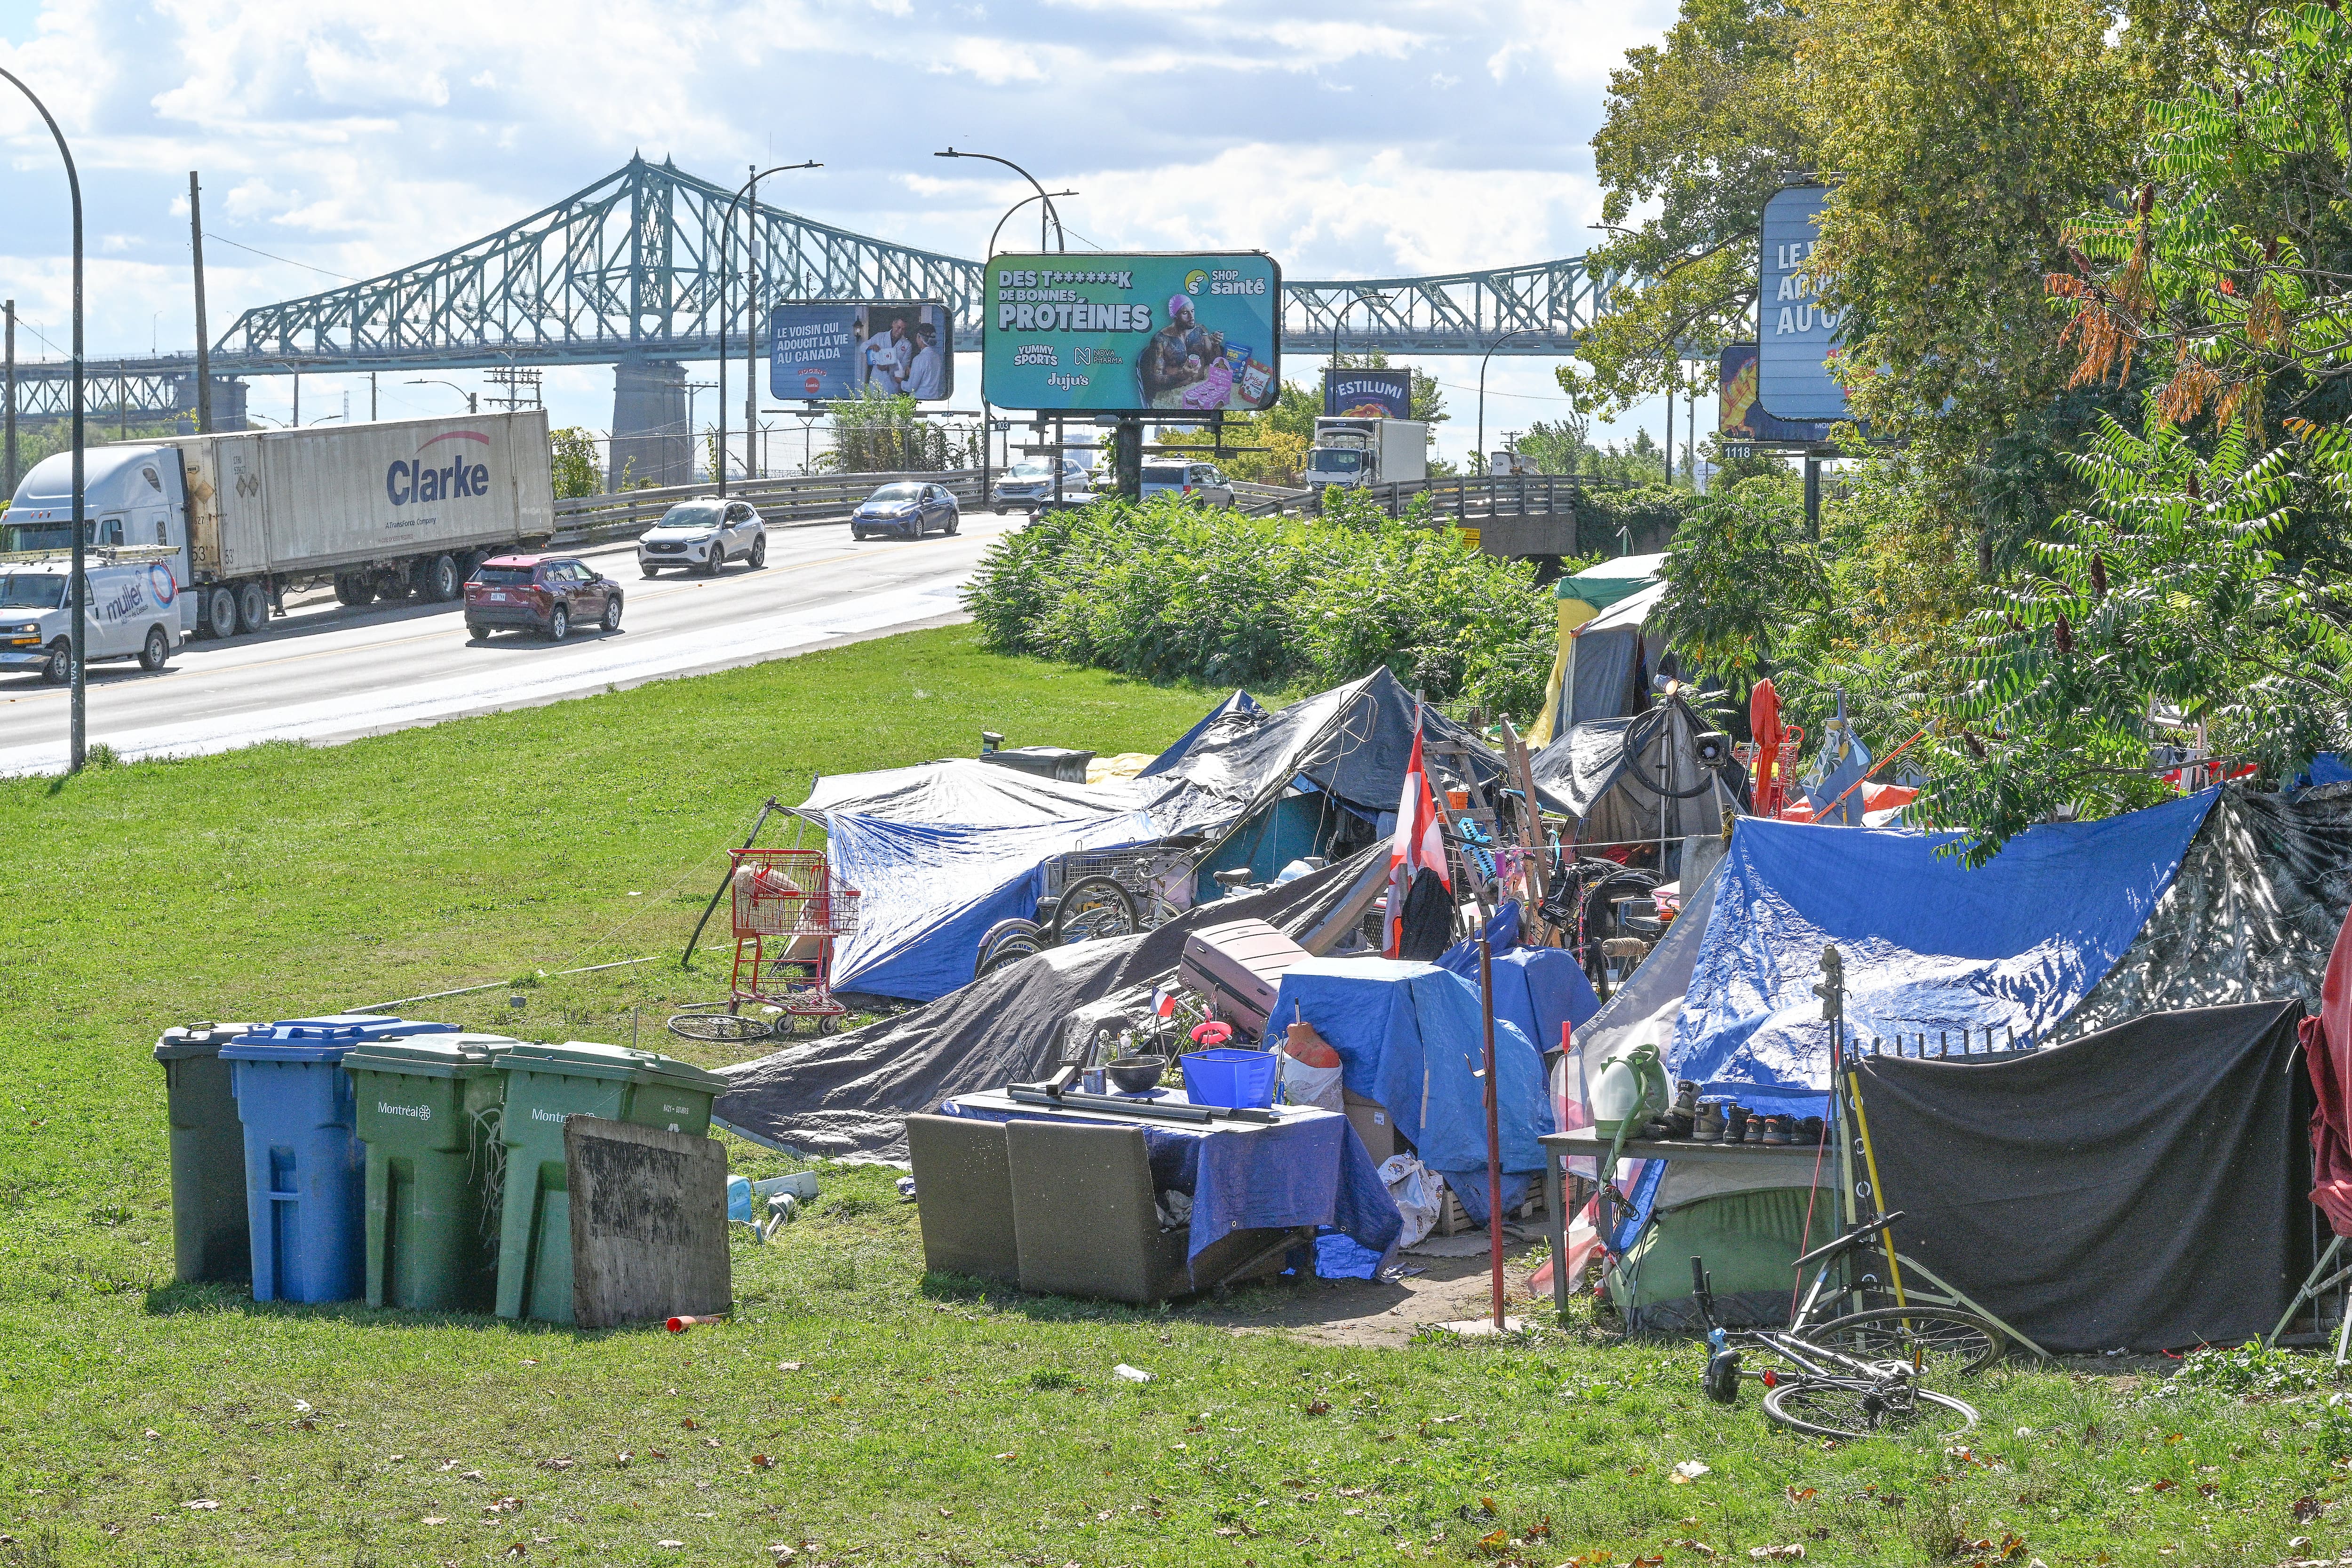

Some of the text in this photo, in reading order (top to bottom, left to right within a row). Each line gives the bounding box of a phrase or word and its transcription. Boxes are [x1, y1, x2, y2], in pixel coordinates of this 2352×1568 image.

[1777, 243, 1802, 269] LE
[999, 270, 1038, 288] DES
[1211, 270, 1239, 281] SHOP
[1210, 278, 1265, 295] santé
[998, 289, 1077, 302] DE BONNES
[998, 297, 1152, 333] PROTÉINES
[1776, 304, 1812, 335] AU
[777, 322, 839, 338] LE VOISIN QUI
[777, 334, 848, 351] ADOUCIT LA VIE
[1018, 344, 1055, 355] YUMMY
[777, 347, 841, 365] AU CANADA
[1014, 354, 1058, 366] SPORTS
[1048, 372, 1089, 391] Juju's
[997, 421, 1009, 430] 103
[1724, 446, 1750, 458] 1118
[386, 454, 489, 506] Clarke
[389, 520, 415, 528] TransForce
[417, 517, 437, 525] Company
[106, 582, 143, 623] muller
[378, 1101, 418, 1117] Montréal
[532, 1108, 566, 1122] Montr
